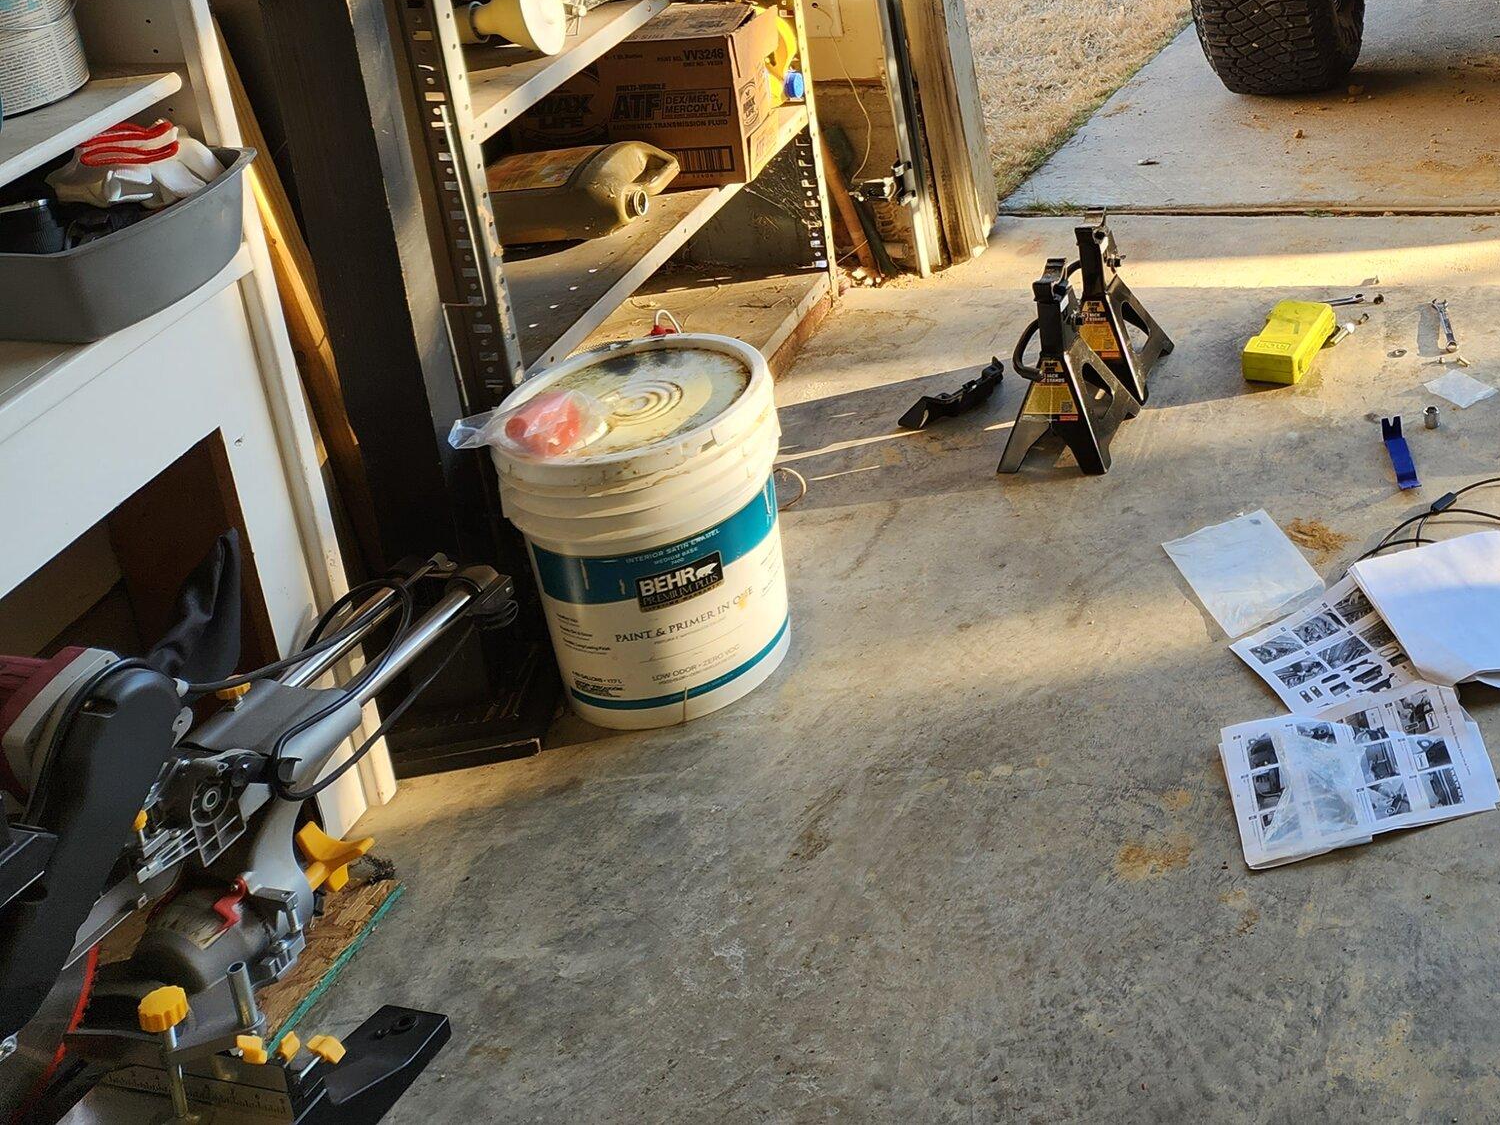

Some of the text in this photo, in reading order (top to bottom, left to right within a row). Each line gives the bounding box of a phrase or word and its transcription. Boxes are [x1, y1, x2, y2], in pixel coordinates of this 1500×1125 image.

[611, 92, 662, 122] ATF
[665, 103, 723, 114] MERCON LV
[626, 549, 664, 564] INTERIOR
[665, 542, 689, 555] SATIN
[638, 566, 696, 597] BEHR
[642, 584, 693, 606] PREMIUM
[694, 573, 719, 590] PLUS
[615, 630, 652, 643] PAINT
[656, 627, 665, 637] &
[668, 609, 716, 634] PRIMER
[717, 603, 731, 616] IN
[651, 672, 671, 682] LOW
[672, 664, 698, 676] ODOR
